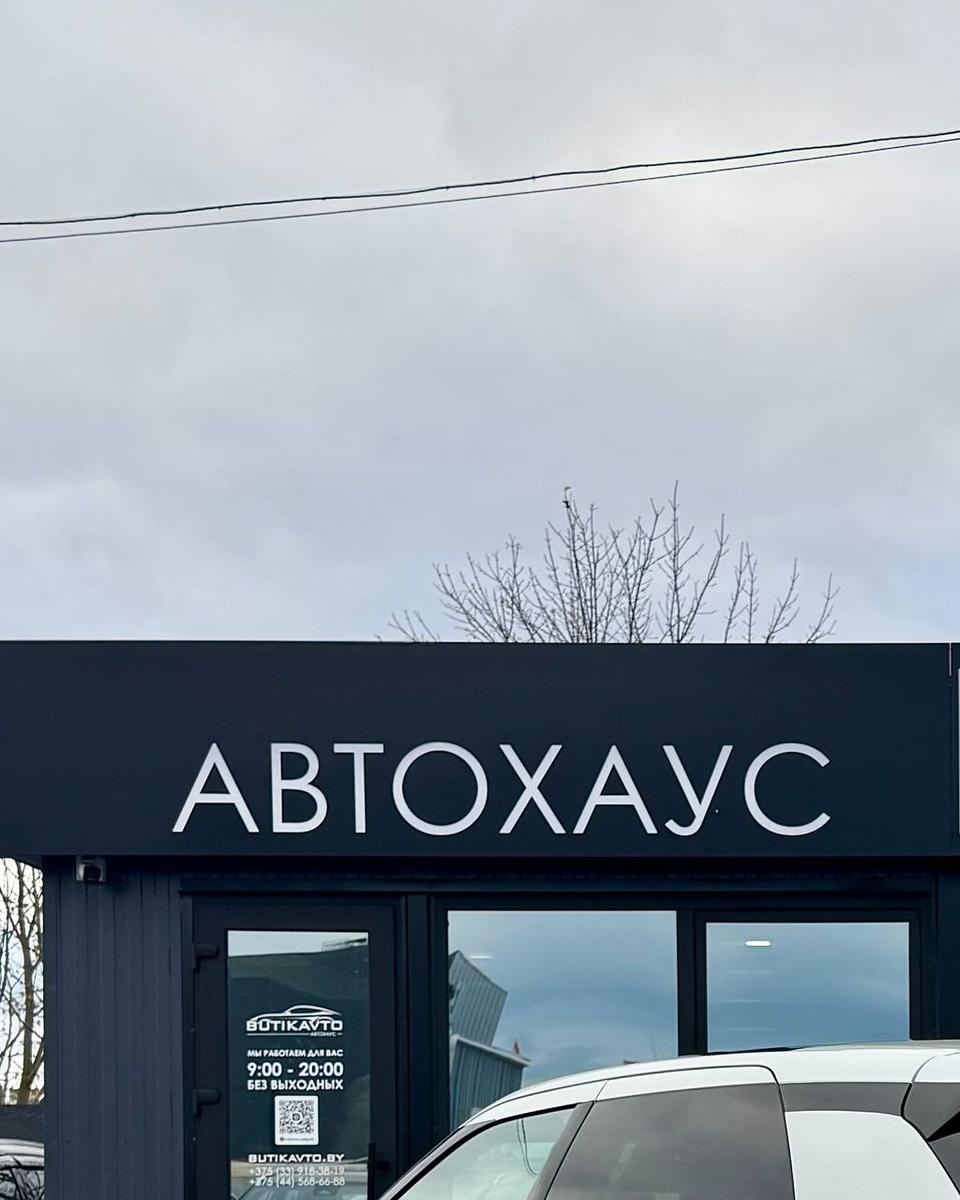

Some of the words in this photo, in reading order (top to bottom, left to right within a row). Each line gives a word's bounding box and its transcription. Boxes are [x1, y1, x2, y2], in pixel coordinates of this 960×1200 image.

[173, 741, 830, 836] АВТОХАУС
[246, 1019, 344, 1032] BUTIKAVTO
[247, 1049, 262, 1057] МЫ
[263, 1049, 306, 1057] РАБОТАЕМ
[307, 1049, 325, 1057] ДЛЯ
[325, 1048, 344, 1057] ВАС
[247, 1061, 283, 1077] 9:00
[298, 1061, 344, 1077] 20:00
[247, 1079, 268, 1091] БЕЗ
[270, 1079, 344, 1091] ВЫХОДНЫХ
[248, 1153, 345, 1163] BUTIKAVTO.BY
[249, 1166, 274, 1177] +375
[276, 1166, 295, 1178] (33)
[276, 1176, 295, 1188] (44)
[297, 1176, 345, 1187] 568-66-88
